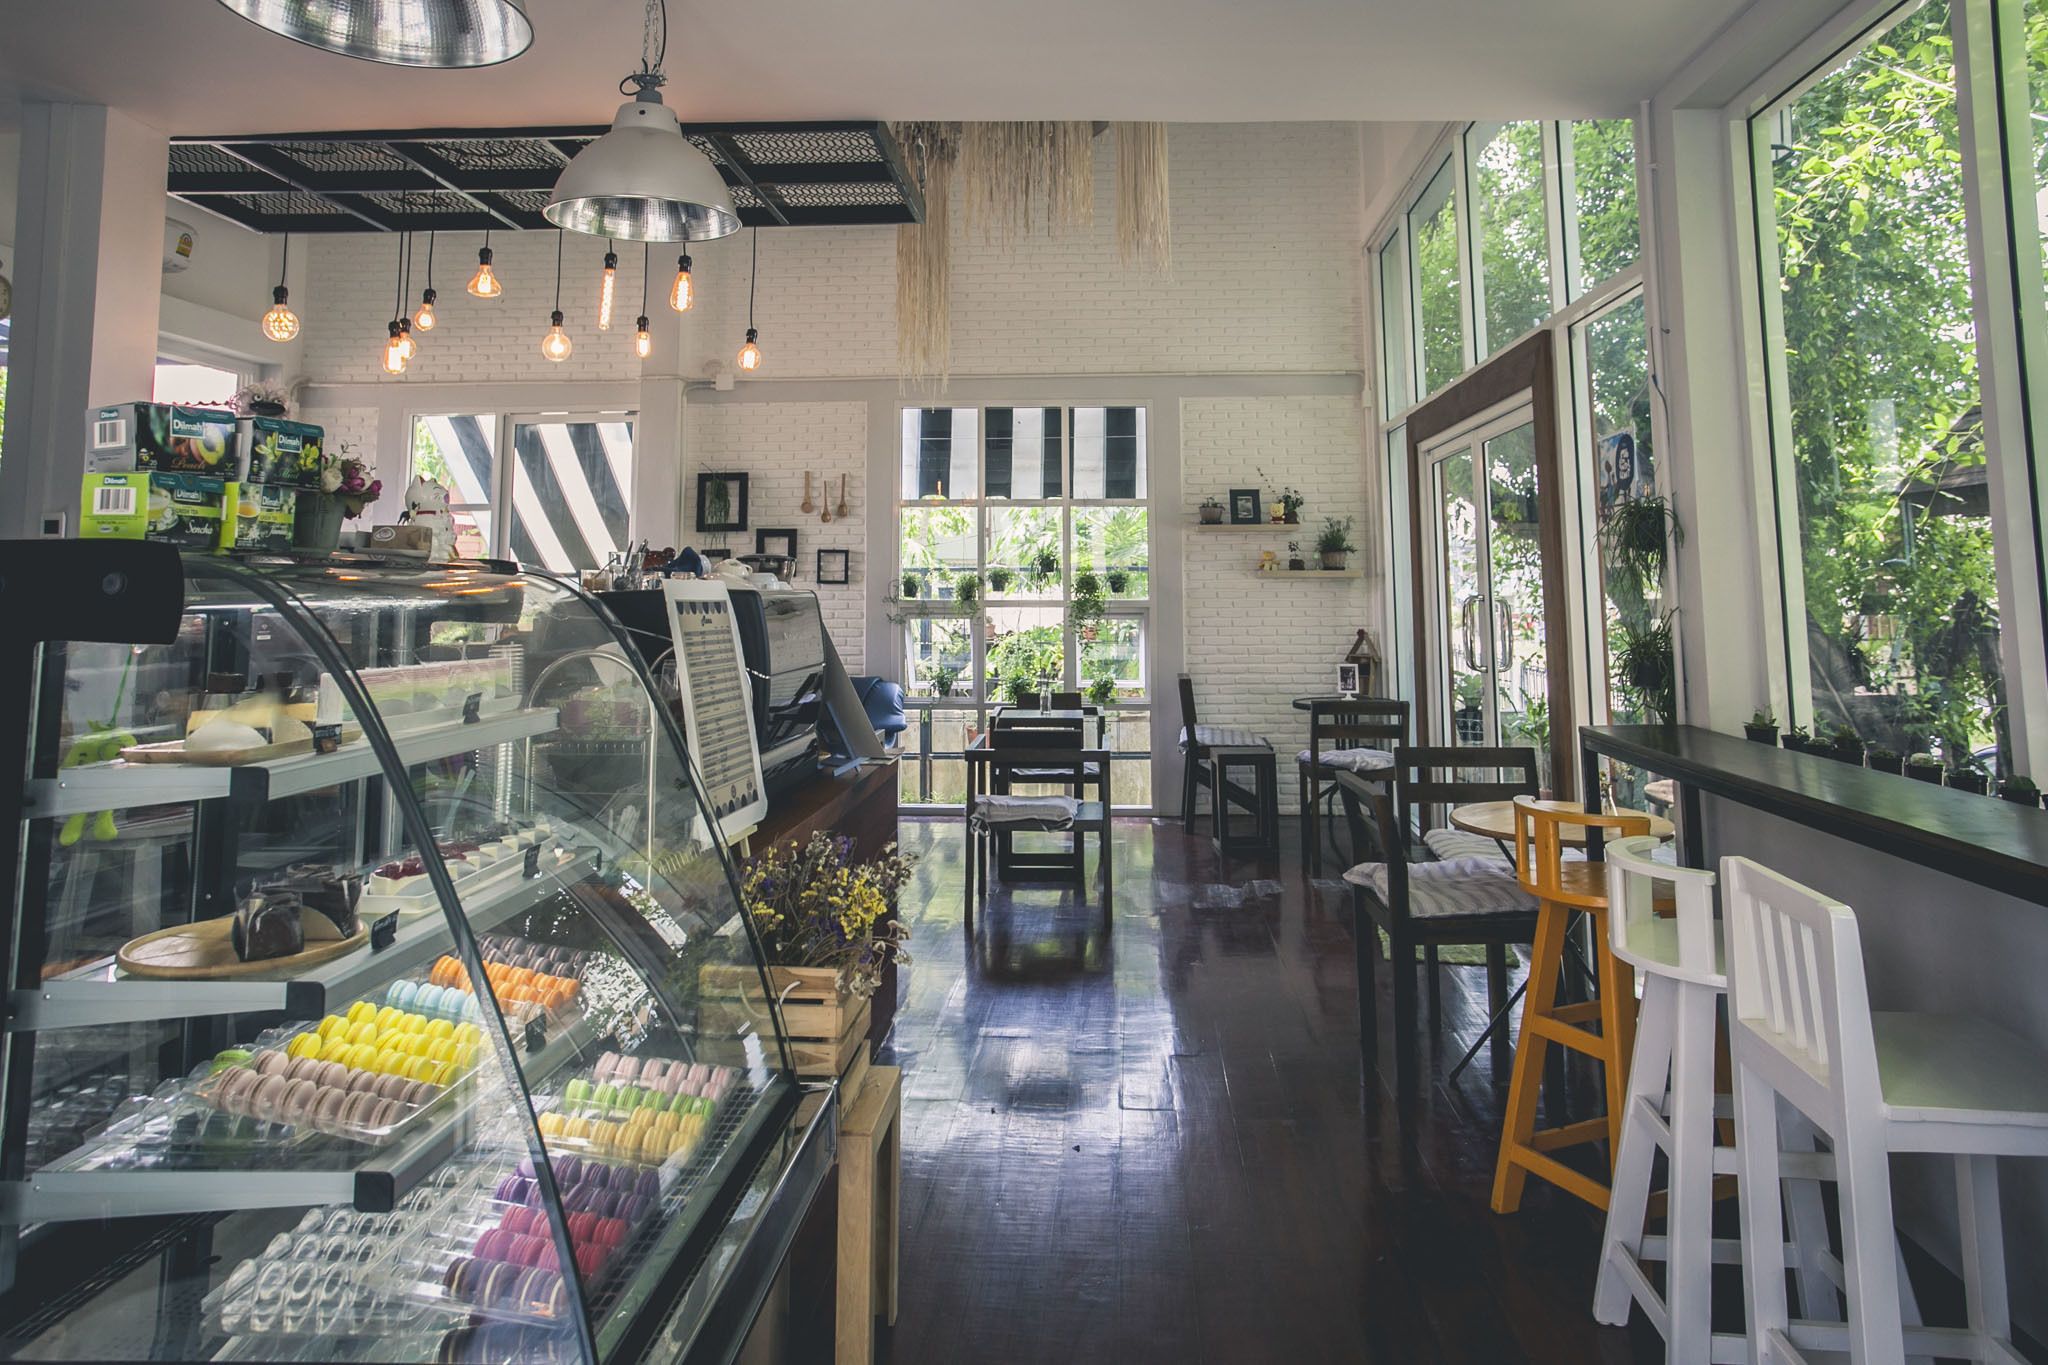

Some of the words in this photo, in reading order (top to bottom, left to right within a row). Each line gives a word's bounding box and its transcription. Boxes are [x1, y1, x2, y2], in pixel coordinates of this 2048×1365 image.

[173, 419, 202, 432] Dilmah
[278, 434, 301, 446] Dilmah
[176, 489, 199, 499] Dilmah
[185, 520, 213, 534] Sencha
